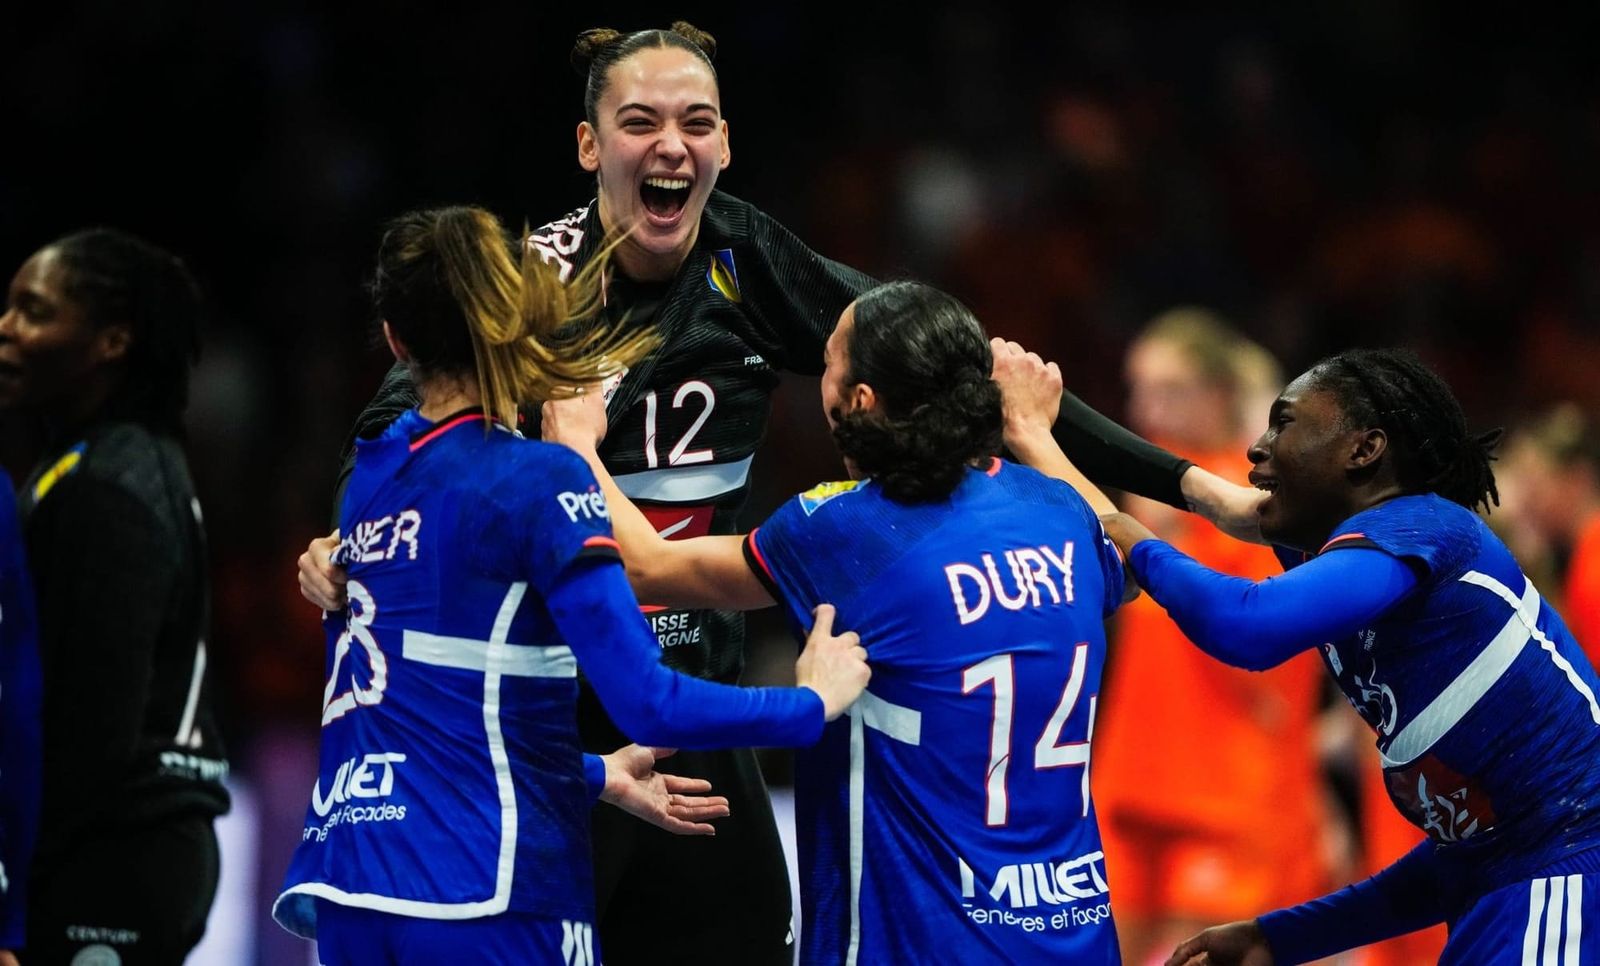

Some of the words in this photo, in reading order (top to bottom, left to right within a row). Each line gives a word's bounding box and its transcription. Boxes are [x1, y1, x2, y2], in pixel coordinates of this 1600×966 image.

[636, 380, 715, 469] 12
[556, 484, 610, 523] Pré
[944, 541, 1074, 625] DURY
[651, 612, 689, 634] ISSE
[658, 626, 700, 649] RGNE
[962, 643, 1096, 828] 14
[1051, 909, 1069, 930] et
[1071, 902, 1112, 925] Faça
